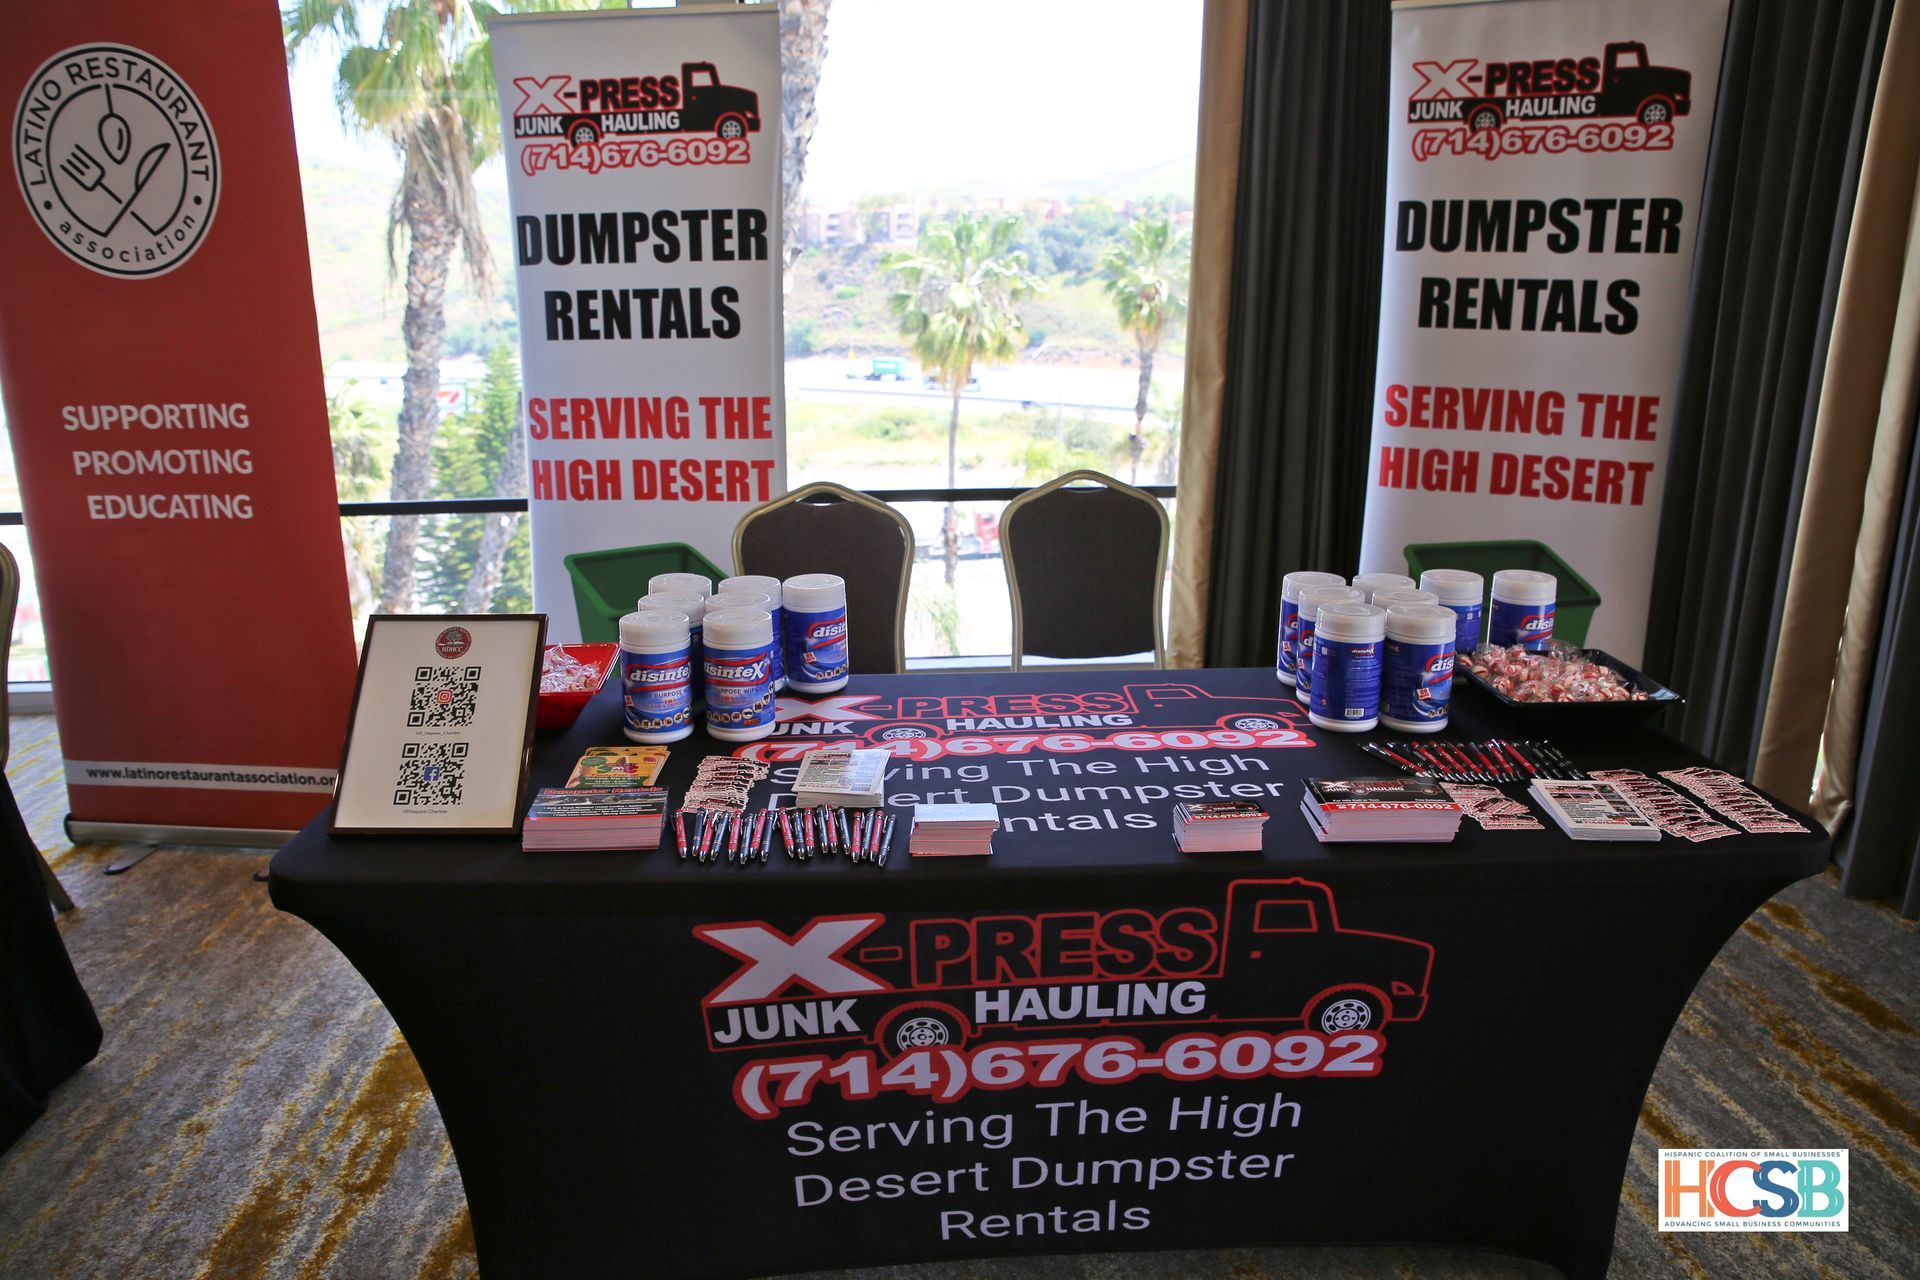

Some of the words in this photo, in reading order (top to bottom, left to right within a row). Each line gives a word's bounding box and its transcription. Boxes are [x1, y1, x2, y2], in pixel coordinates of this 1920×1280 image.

[513, 75, 681, 115] X-PRESS
[1409, 57, 1601, 100] X-PRESS
[29, 79, 62, 186] LATINO
[65, 57, 212, 182] RESTAURANT
[515, 116, 564, 136] JUNK
[601, 111, 680, 132] HAULING
[1410, 100, 1464, 120] JUNK
[1505, 95, 1596, 117] HAULING
[521, 138, 750, 176] (714)676-6092
[1412, 122, 1674, 162] (714)676-6092
[58, 213, 196, 264] association
[516, 208, 768, 266] DUMPSTER
[1396, 197, 1684, 254] DUMPSTER
[544, 286, 741, 341] RENTALS
[1418, 276, 1641, 335] RENTALS
[62, 403, 250, 431] SUPPORTING
[529, 396, 690, 440] SERVING
[699, 397, 773, 439] THE
[1384, 384, 1565, 436] SERVING
[1577, 393, 1660, 441] THE
[72, 449, 254, 475] PROMOTING
[532, 459, 622, 501] HIGH
[632, 459, 775, 502] DESERT
[1379, 446, 1480, 493] HIGH
[1489, 452, 1654, 506] DESERT
[87, 494, 254, 520] EDUCATING
[630, 663, 691, 682] disinfe
[947, 714, 1133, 731] HAULING
[86, 765, 334, 787] www.latinorestaurantassociation.or
[1007, 758, 1117, 777] The
[1136, 754, 1270, 777] High
[992, 781, 1284, 804] Dumpster
[1003, 809, 1158, 833] ntals
[693, 907, 1220, 1005] X-PRESS
[712, 998, 862, 1044] JUNK
[974, 980, 1208, 1024] HAULING
[735, 1032, 1384, 1118] (714)676-6092
[786, 1108, 1014, 1157] Serving
[1035, 1098, 1148, 1138] The
[1168, 1092, 1302, 1136] High
[793, 1160, 989, 1208] Desert
[1011, 1146, 1297, 1189] Dumpster
[939, 1199, 1152, 1241] Rentals
